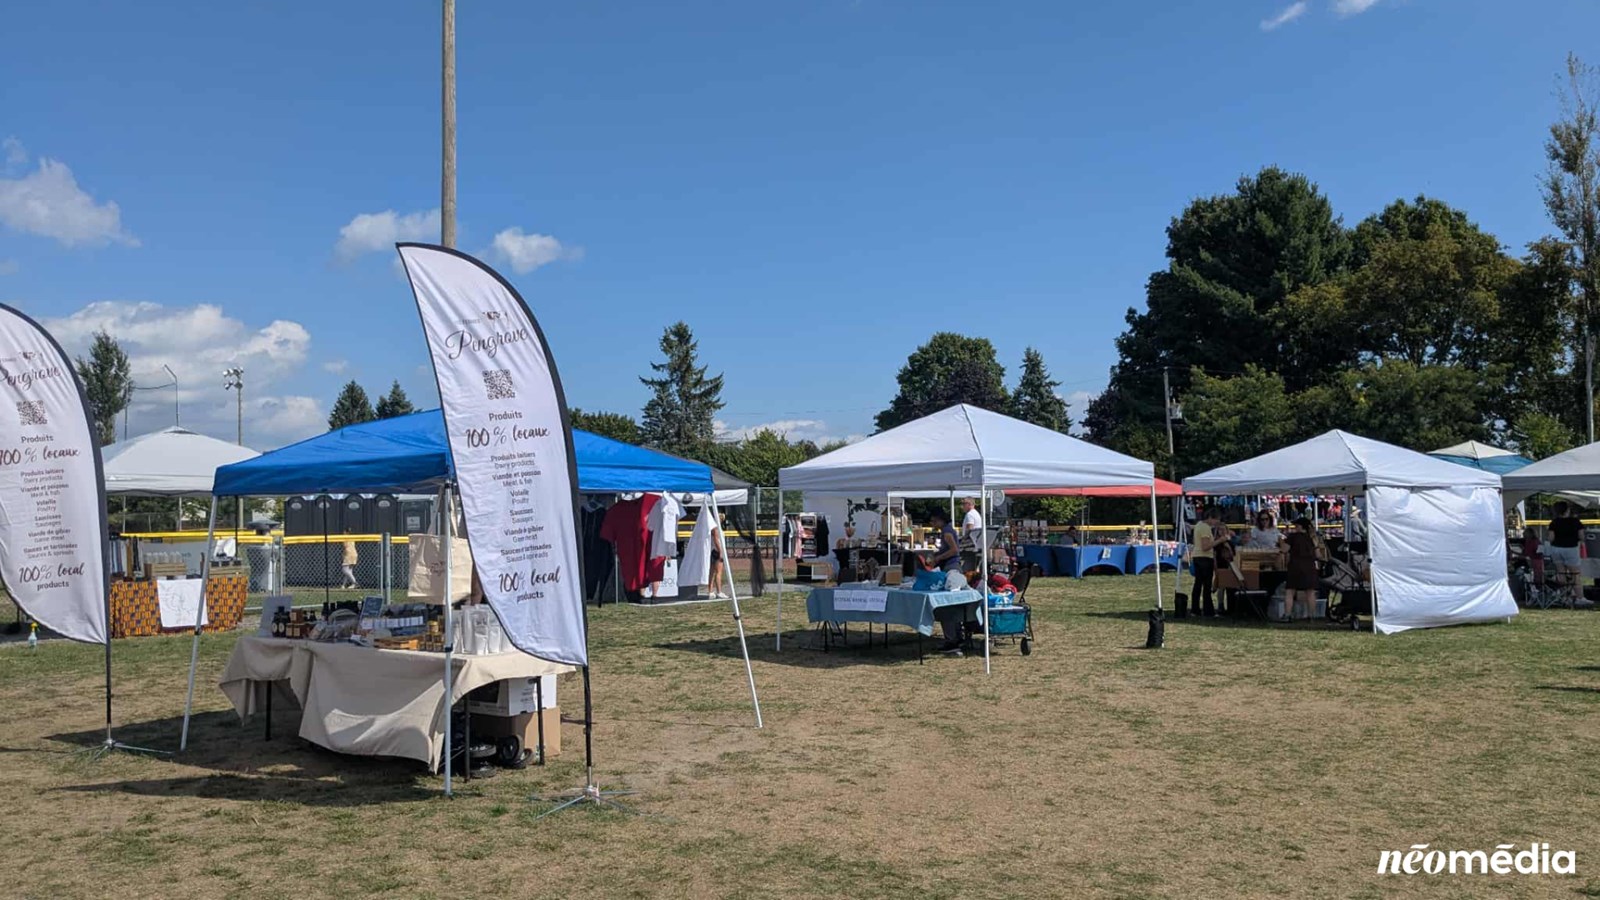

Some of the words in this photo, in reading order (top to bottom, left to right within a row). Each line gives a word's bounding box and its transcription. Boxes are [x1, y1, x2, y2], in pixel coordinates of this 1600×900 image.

[489, 410, 523, 421] Produits
[21, 435, 54, 443] Produits
[465, 428, 490, 448] 100
[513, 424, 550, 442] locaux
[43, 445, 79, 460] locaux
[490, 453, 516, 462] Produits
[511, 460, 535, 468] products
[39, 475, 63, 483] products
[491, 473, 512, 481] Viande
[20, 485, 39, 493] Viande
[28, 530, 46, 538] Viande
[57, 562, 84, 577] local
[530, 565, 561, 586] local
[37, 581, 69, 591] products
